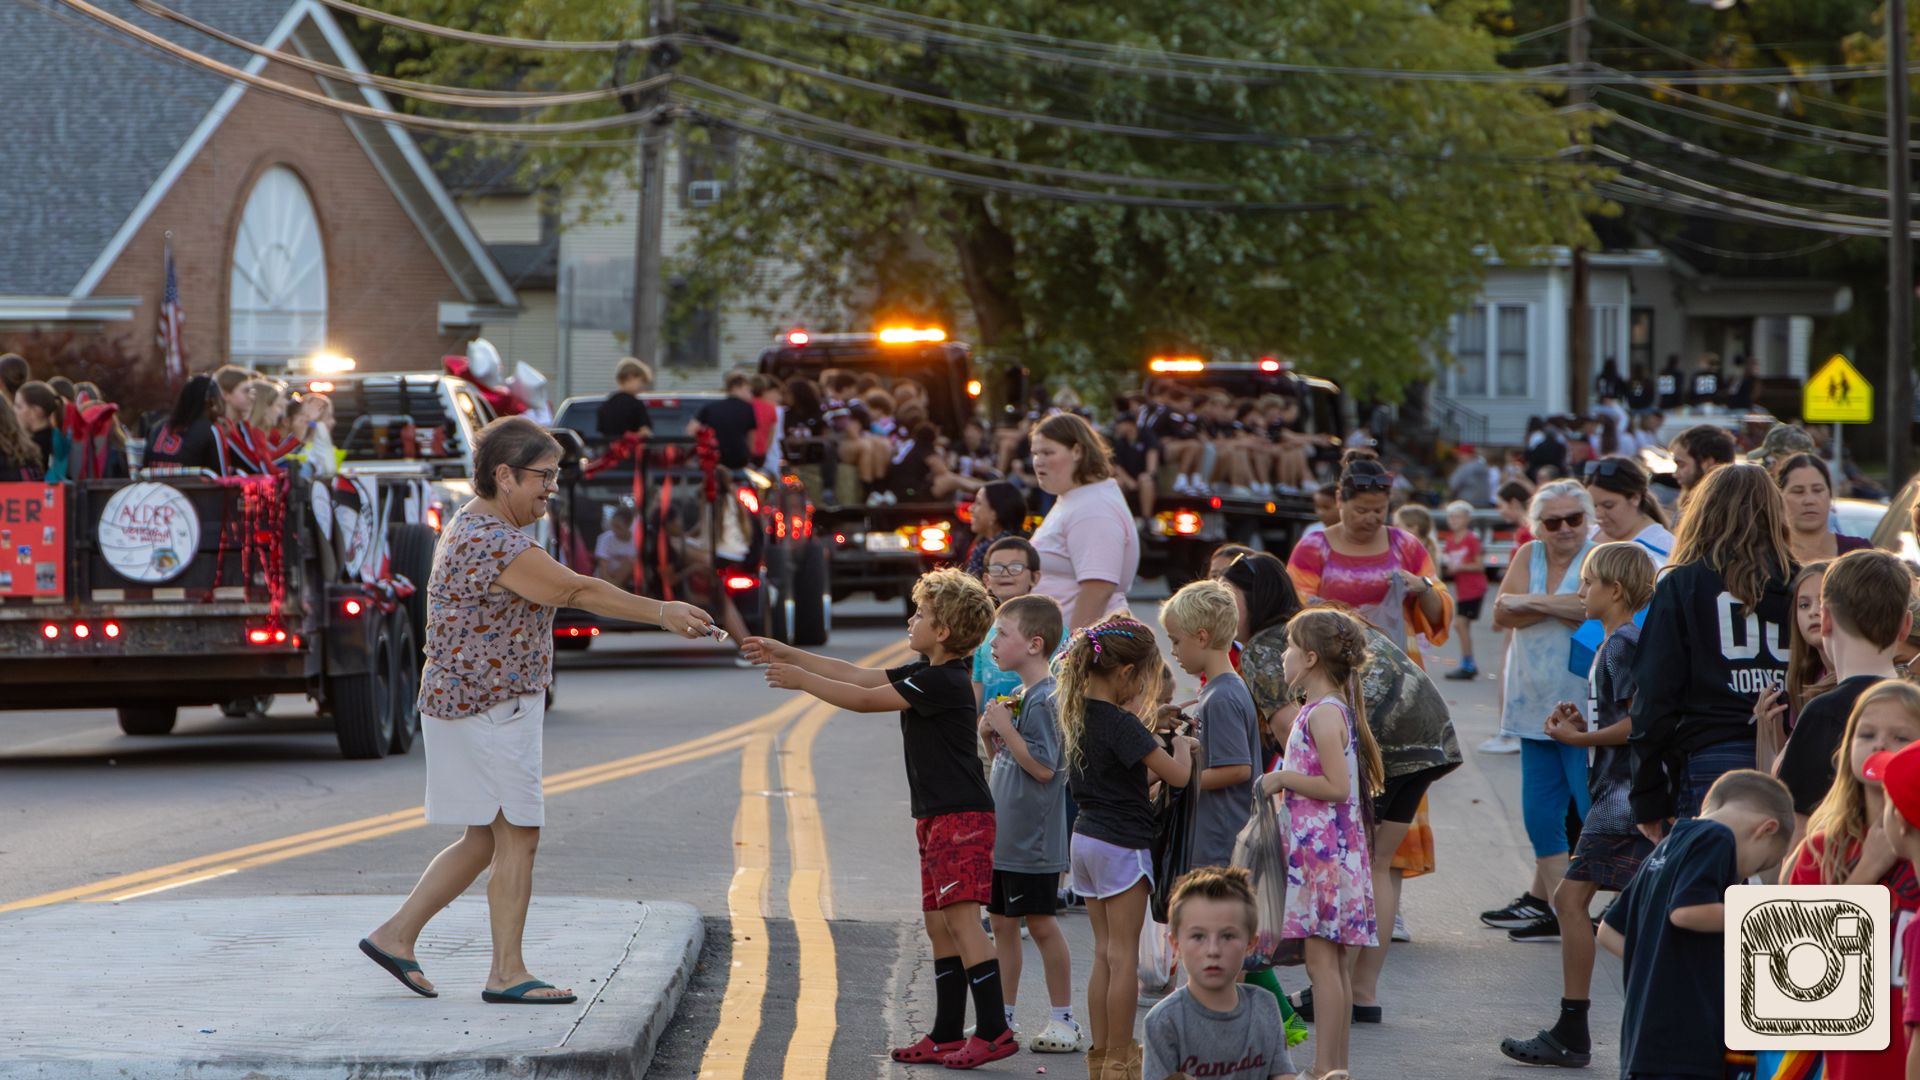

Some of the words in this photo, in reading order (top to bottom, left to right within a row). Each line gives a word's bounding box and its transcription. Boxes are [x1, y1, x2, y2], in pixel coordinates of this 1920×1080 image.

[119, 503, 175, 526] ALDER
[1727, 668, 1789, 694] JOHNS
[1181, 1046, 1267, 1078] Canada
